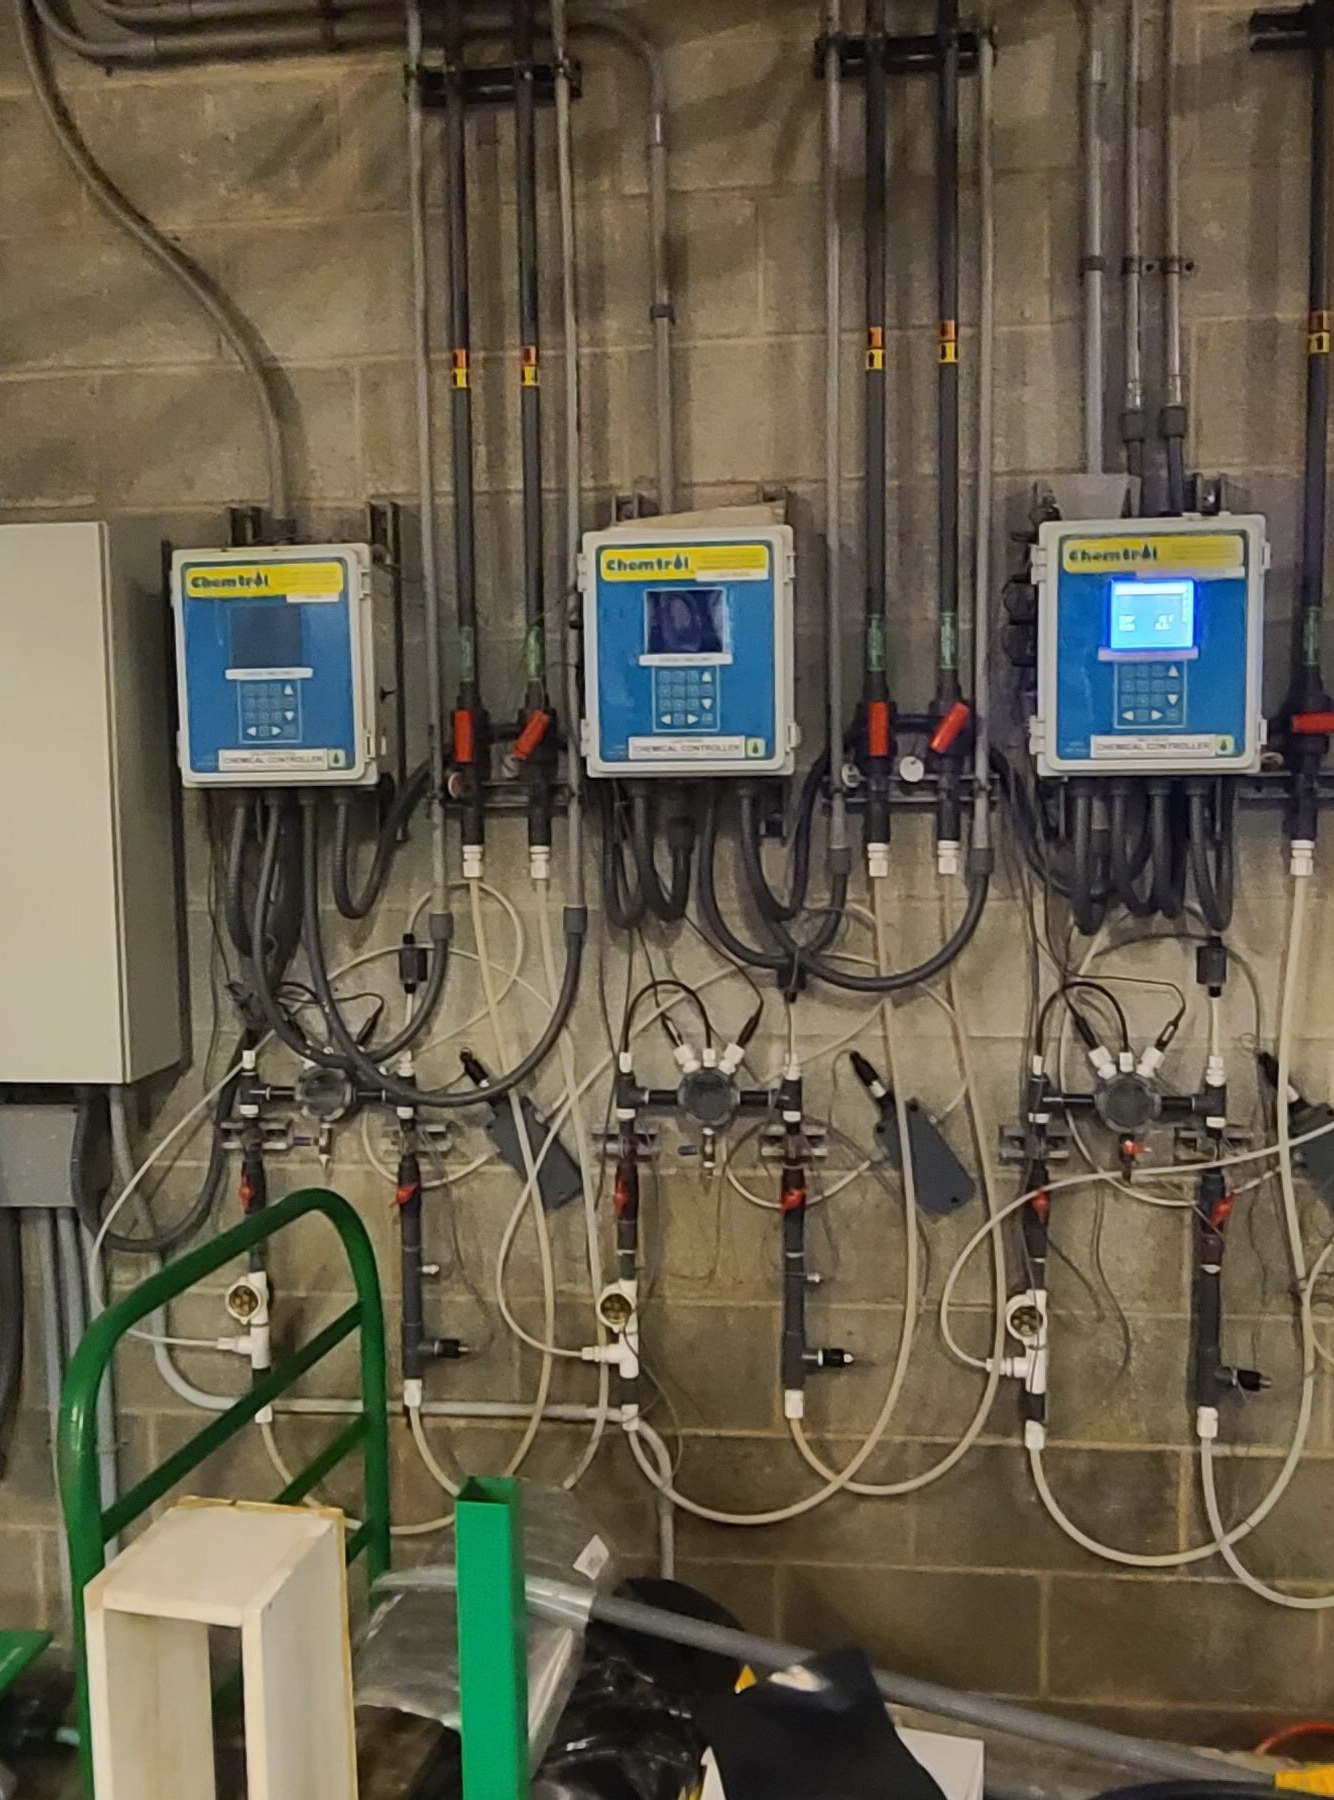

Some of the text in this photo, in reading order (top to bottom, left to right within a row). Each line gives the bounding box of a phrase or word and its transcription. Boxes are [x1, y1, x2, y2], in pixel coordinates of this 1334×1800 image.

[606, 553, 689, 571] Chemtrol
[1069, 544, 1157, 562] Chemtrol
[191, 571, 269, 588] Chemtrol
